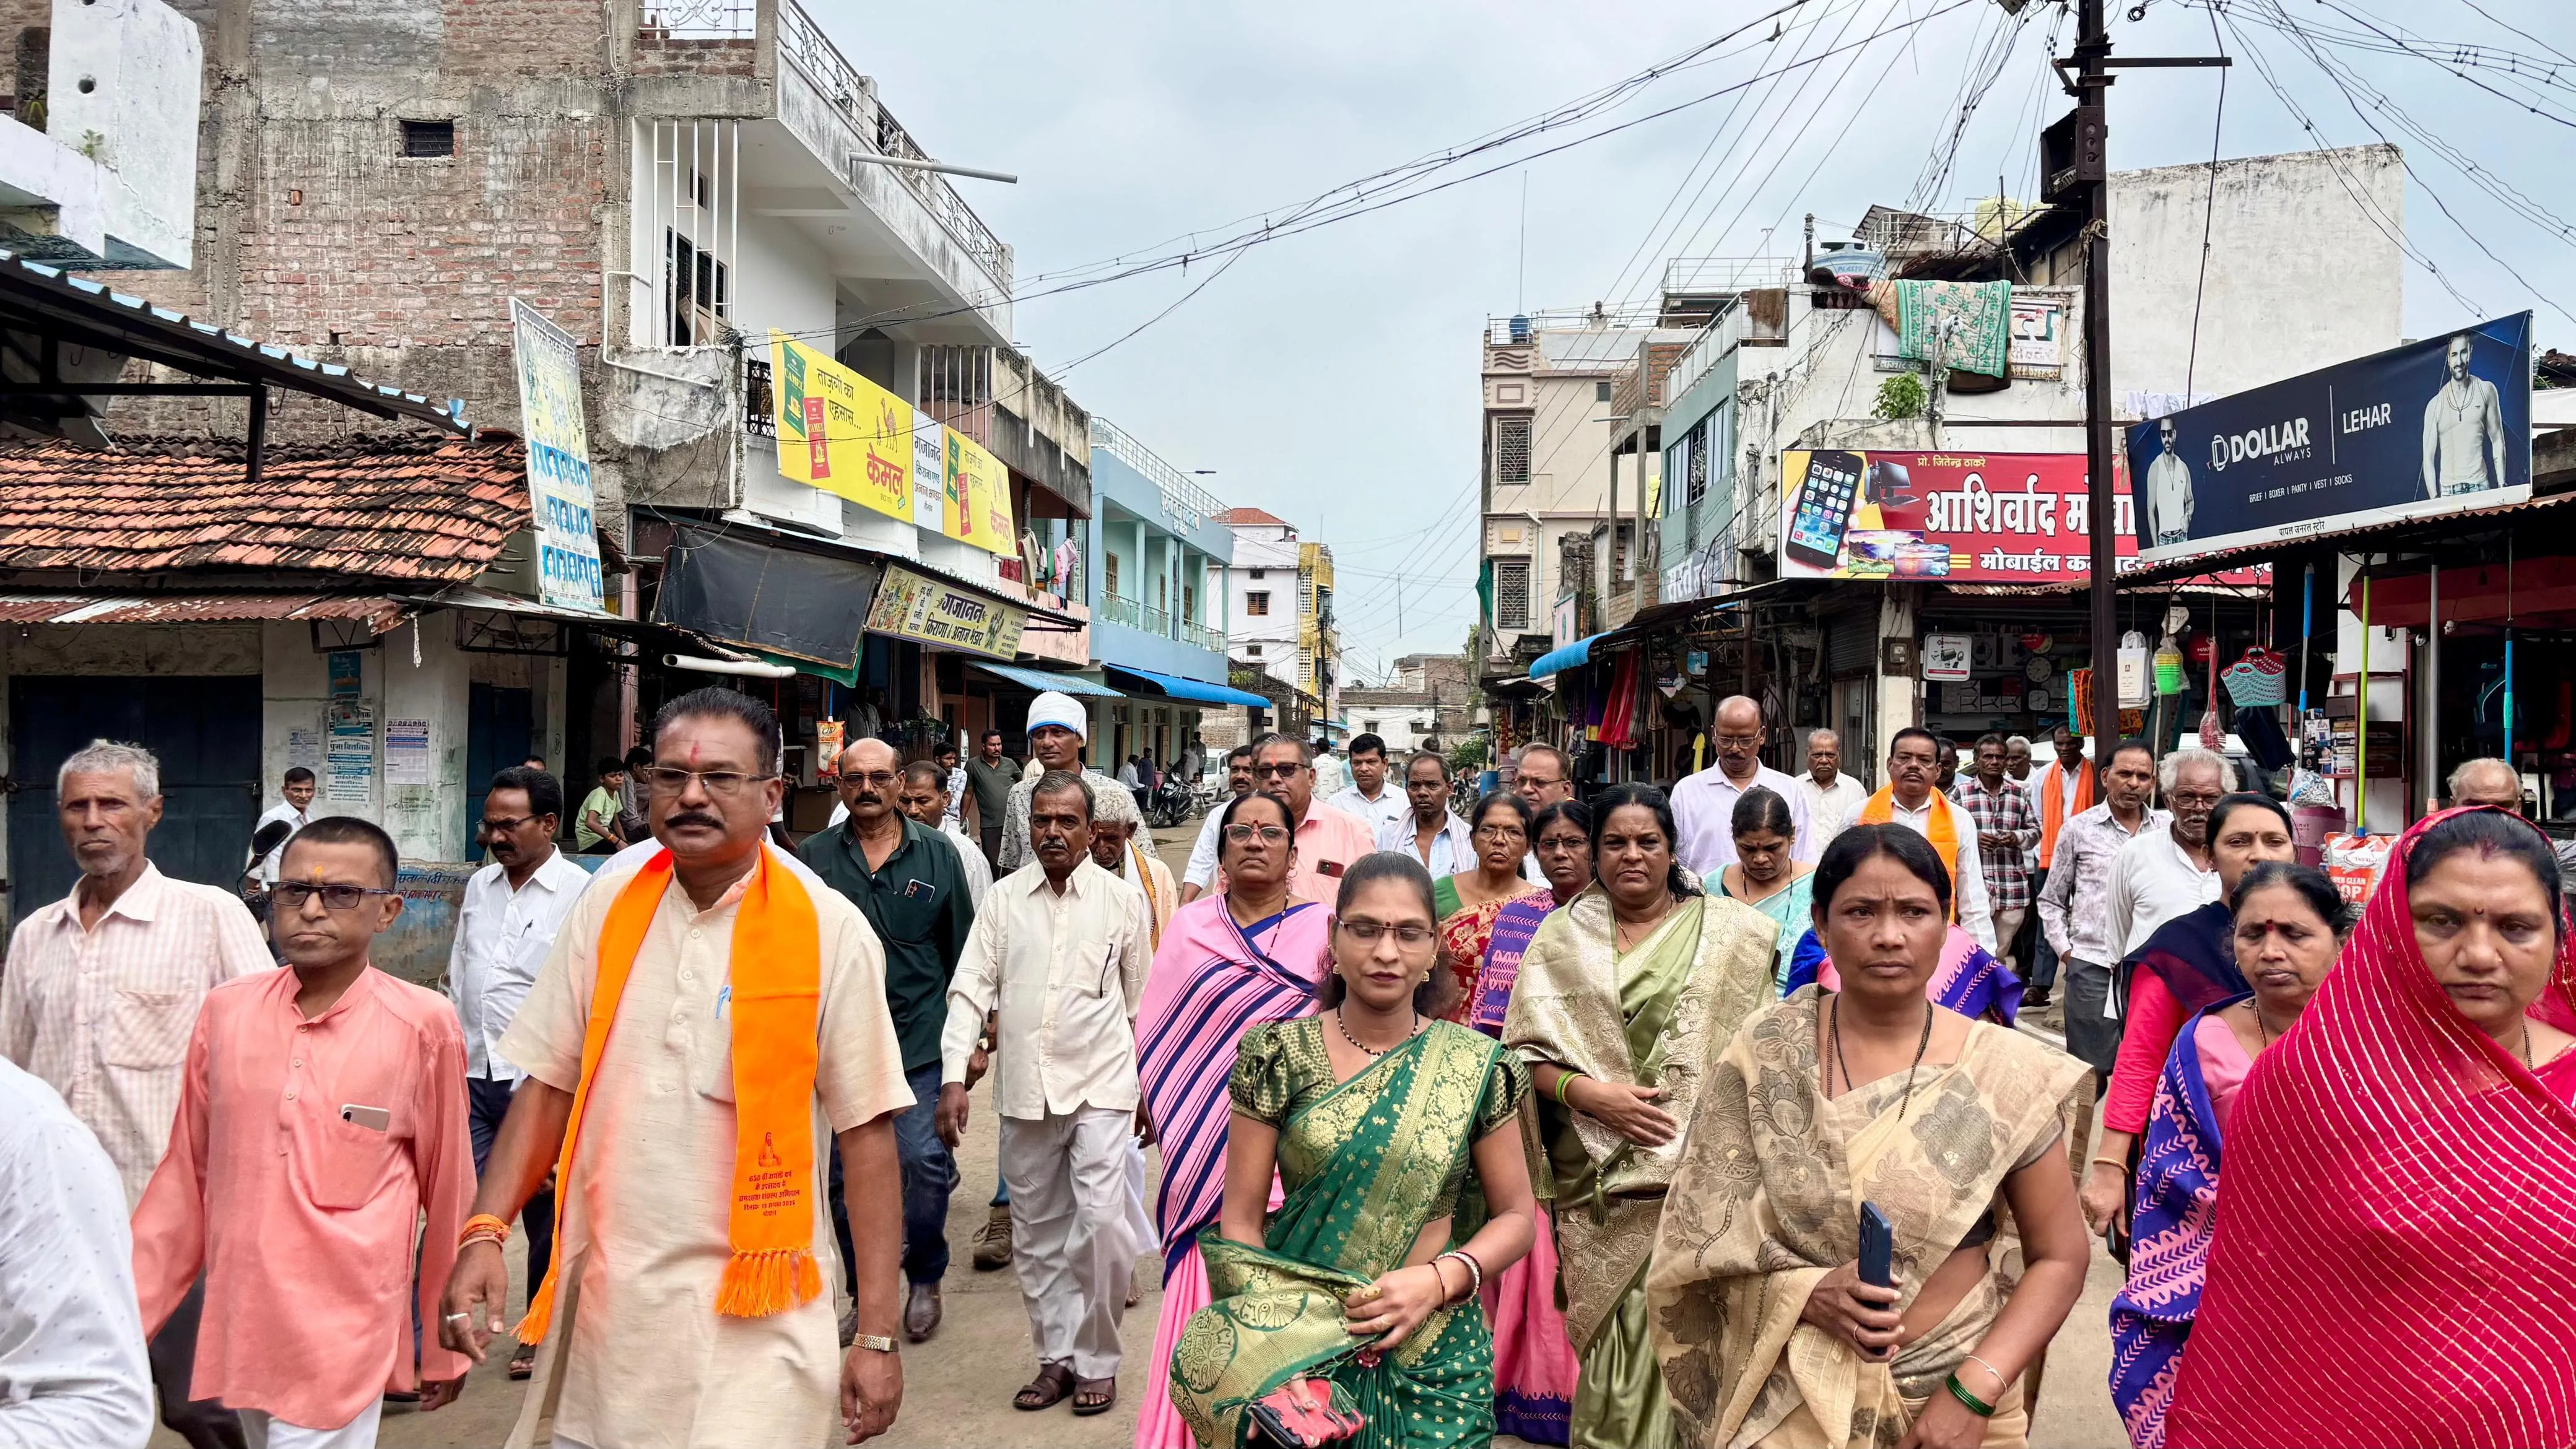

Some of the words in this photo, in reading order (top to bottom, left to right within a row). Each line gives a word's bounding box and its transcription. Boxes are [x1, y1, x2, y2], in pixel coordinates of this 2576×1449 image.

[785, 368, 803, 391] CAMEL
[843, 382, 854, 400] का
[2343, 402, 2391, 434] LEHAR
[915, 435, 941, 465] गजानंद
[2230, 417, 2310, 463] DOLLAR
[867, 442, 904, 497] केमल
[1933, 455, 1962, 468] जितेन्द्र
[1963, 455, 1986, 468] ठाकरे
[2274, 447, 2312, 466] ALWAYS
[2249, 492, 2263, 503] BRIEF
[2269, 487, 2285, 500] BOXER
[2291, 482, 2307, 495] PANTY
[2314, 479, 2327, 490] VEST
[2334, 474, 2352, 486] SOCKS
[1924, 472, 2058, 537] आशिर्वाद
[2313, 519, 2325, 531] स्टोर
[1979, 547, 2061, 574] मोबाईल
[941, 593, 986, 624] गजानन
[923, 612, 949, 638] किराणा
[951, 626, 971, 642] अनाज
[970, 625, 985, 646] भंडार
